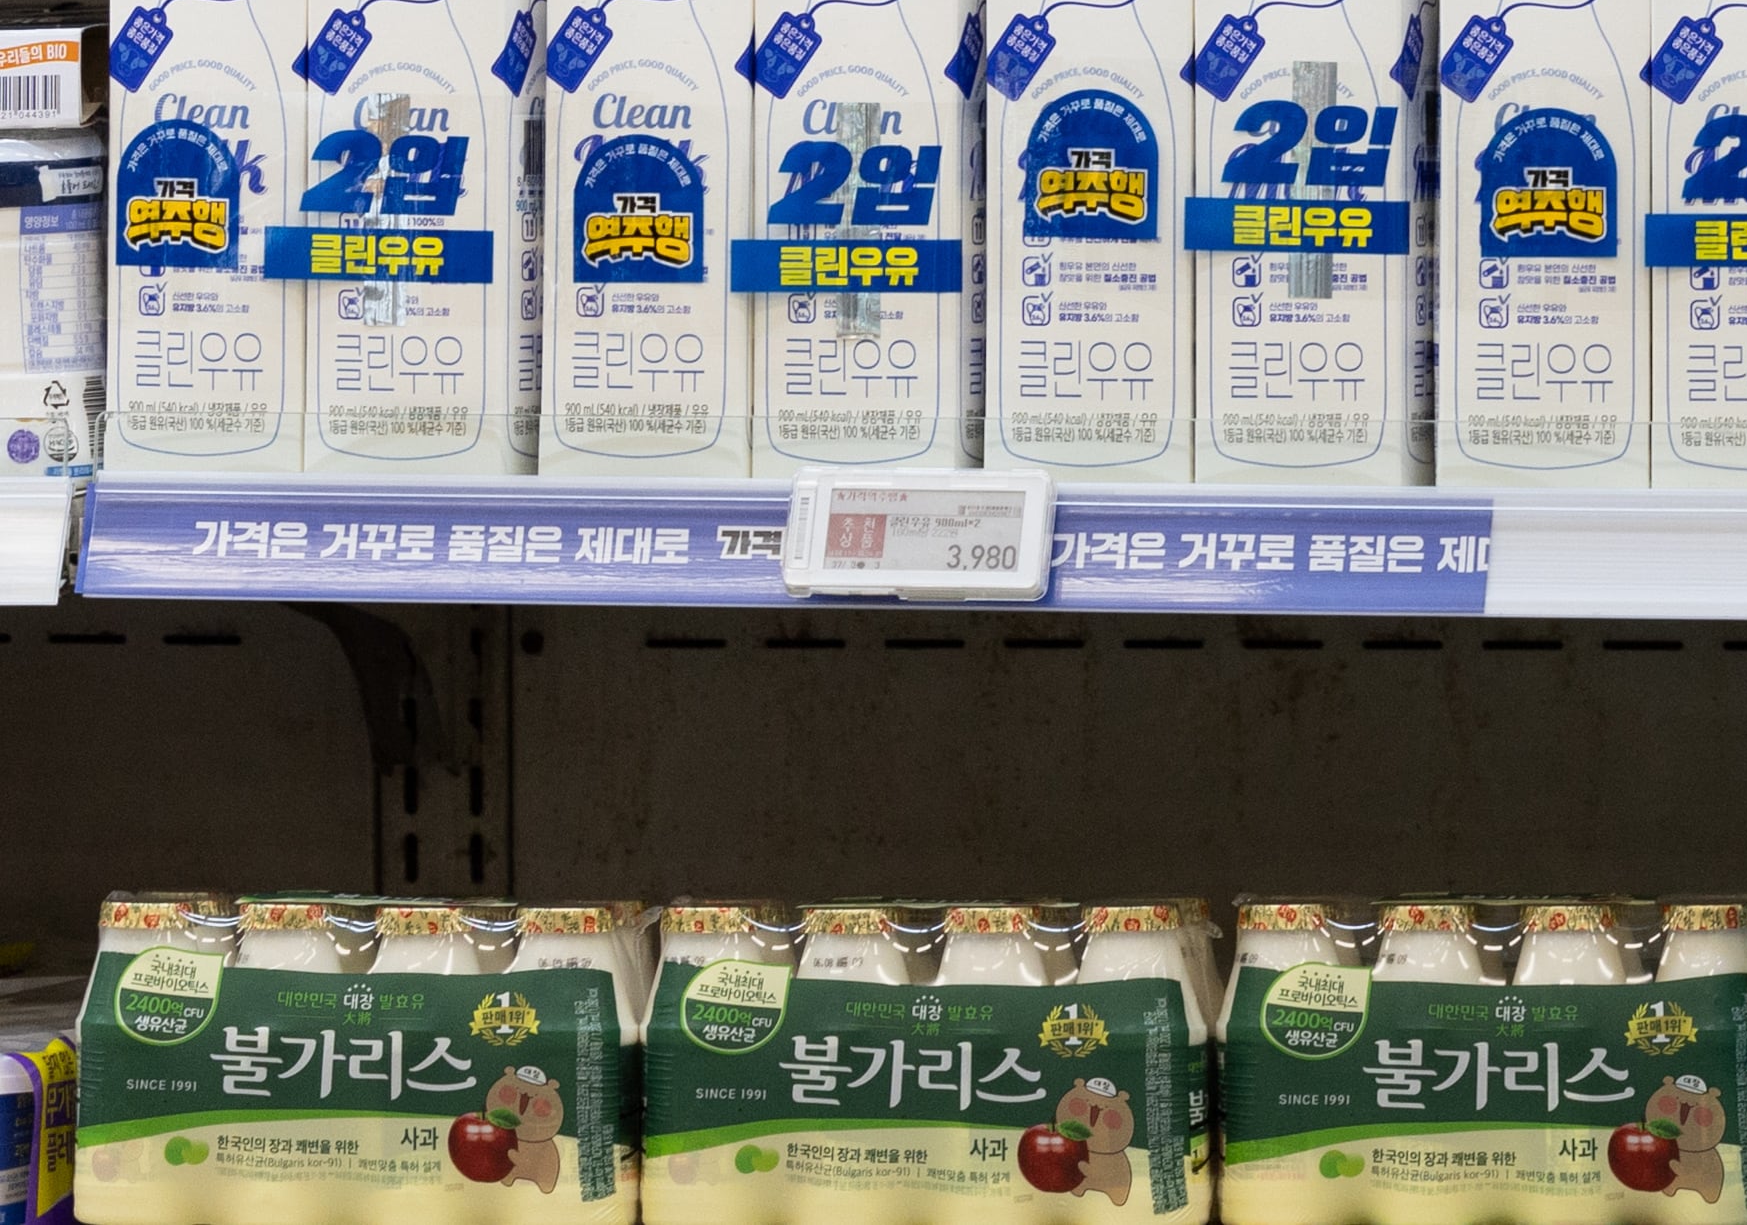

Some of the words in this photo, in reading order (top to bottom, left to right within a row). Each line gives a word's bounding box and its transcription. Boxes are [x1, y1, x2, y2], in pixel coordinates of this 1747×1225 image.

[46, 43, 67, 60] BIO
[592, 94, 692, 129] Clean
[300, 129, 470, 215] 2입
[159, 180, 195, 198] 가격
[616, 196, 656, 213] 가격
[127, 199, 228, 250] 역주행
[584, 215, 692, 265] 역주행
[310, 235, 445, 276] 클린우유
[571, 331, 704, 392] 클린우유
[193, 520, 308, 559] 가격은
[321, 522, 434, 561] 거꾸로
[449, 525, 562, 563] 품질은
[575, 528, 690, 565] 제대로
[1051, 532, 1166, 570] 가격은
[1178, 533, 1295, 572] 거꾸로
[1309, 535, 1422, 573] 품질은
[947, 544, 1017, 571] 3,980
[150, 960, 197, 979] 국내최대
[126, 996, 184, 1019] 2400억
[184, 1006, 205, 1020] CFU
[277, 990, 338, 1010] 대한민국
[343, 991, 373, 1011] 대장
[379, 991, 425, 1012] 발효유
[135, 1015, 187, 1035] 생유산균
[210, 1026, 477, 1101] 불가리스
[779, 1036, 1047, 1110] 불가리스
[1362, 1039, 1636, 1112] 불가리스
[126, 1078, 168, 1092] SINCE
[170, 1079, 198, 1093] 1991
[216, 1136, 266, 1154] 한국인의
[268, 1137, 292, 1154] 장과
[295, 1137, 331, 1155] 쾌변을
[334, 1137, 359, 1156] 위한
[401, 1127, 440, 1153] 사과
[1558, 1138, 1597, 1163] 사과
